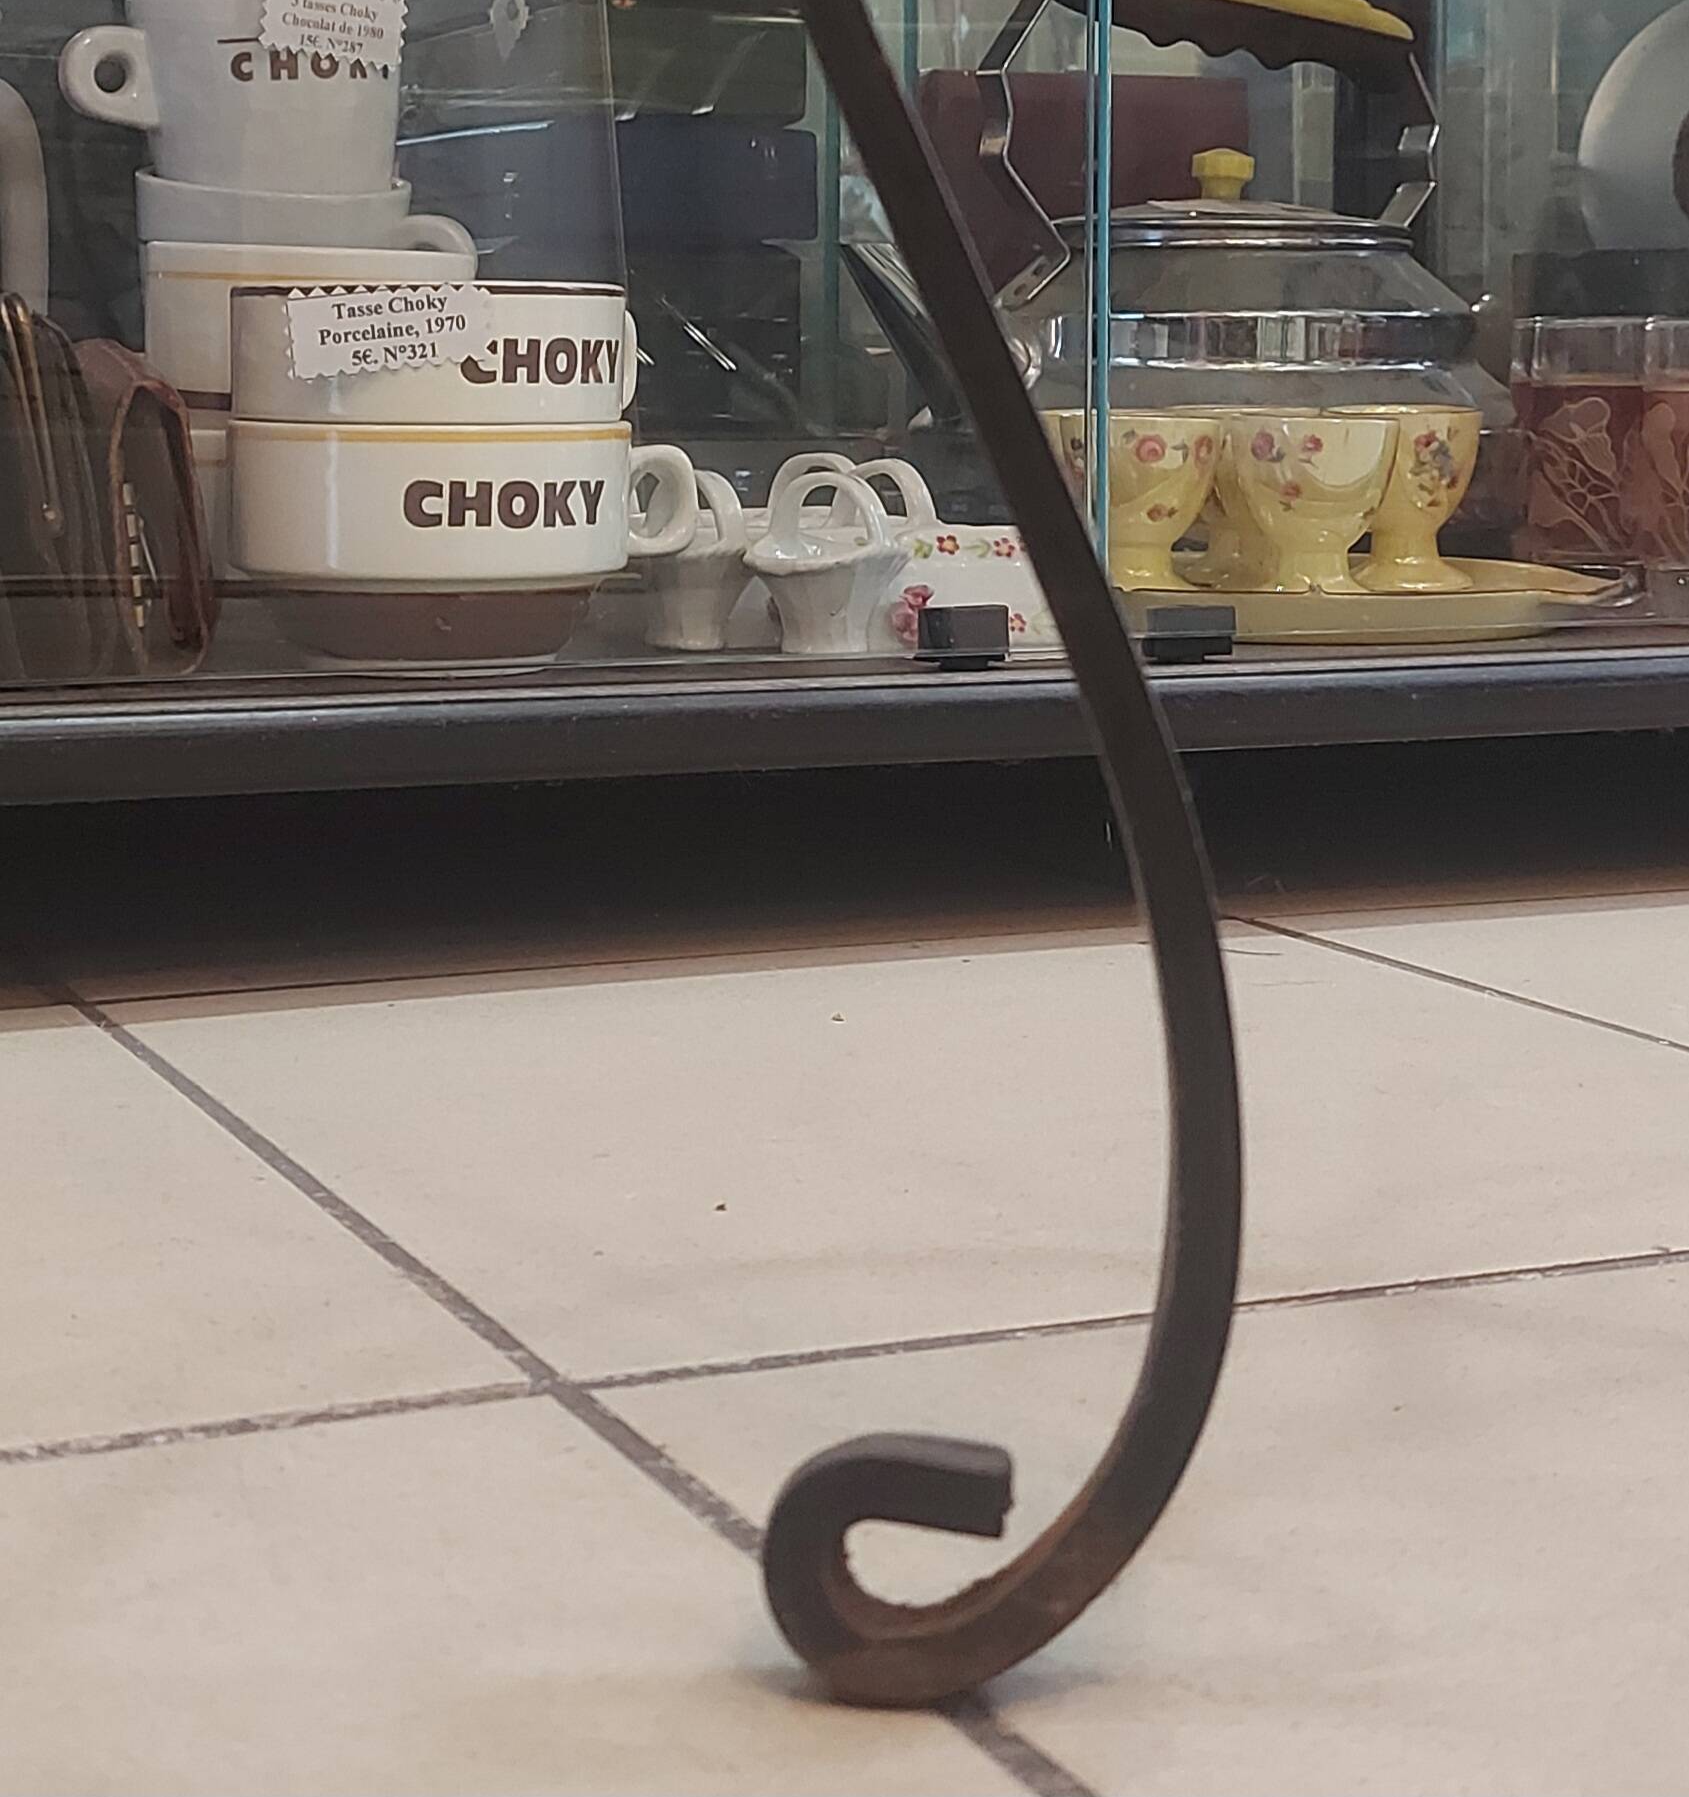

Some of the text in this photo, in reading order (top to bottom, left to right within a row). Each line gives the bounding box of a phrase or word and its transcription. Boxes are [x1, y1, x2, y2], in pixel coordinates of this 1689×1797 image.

[281, 11, 385, 40] Chocolat de 1980
[339, 2, 379, 24] Choky
[331, 295, 449, 320] Tasse Choky
[318, 313, 467, 346] Porcelaine, 1970
[351, 341, 440, 367] 5€. N°321
[403, 479, 606, 529] CHOKY
